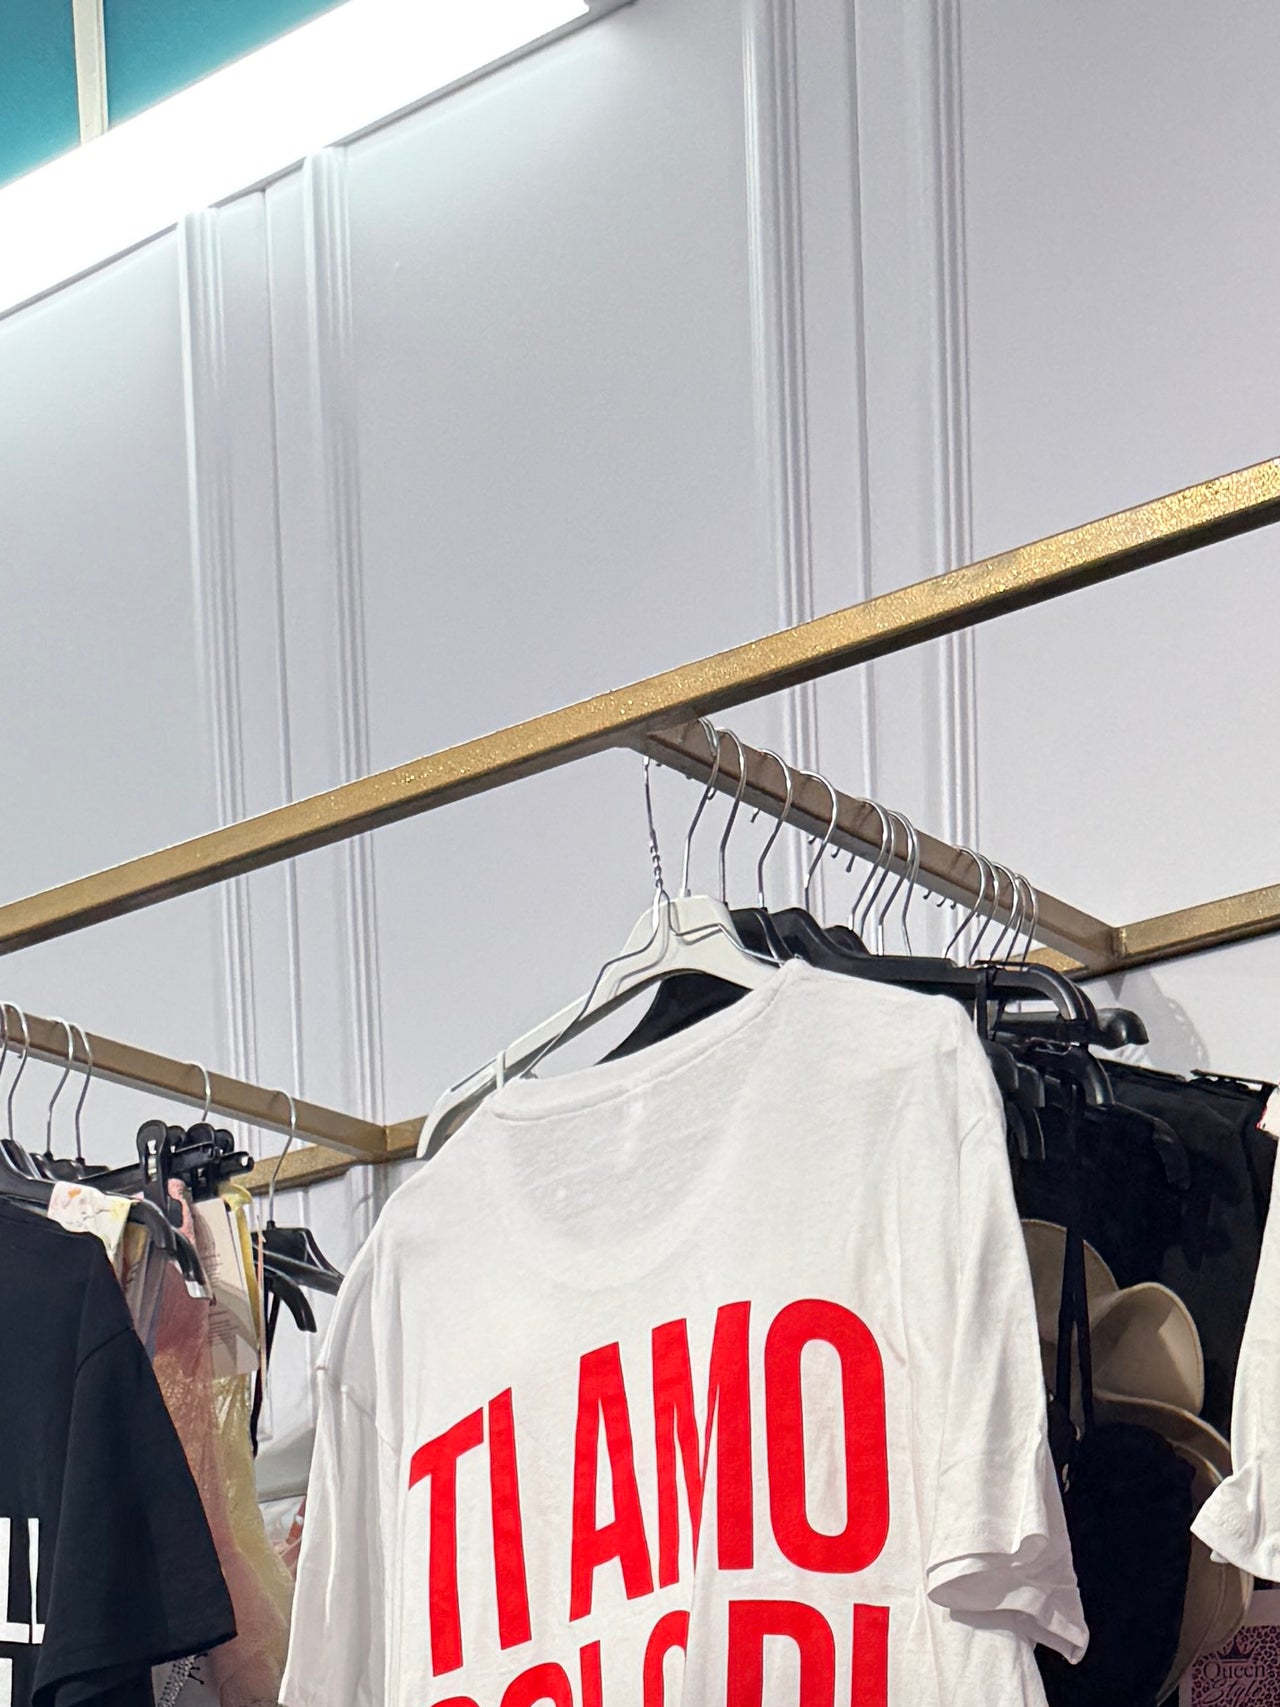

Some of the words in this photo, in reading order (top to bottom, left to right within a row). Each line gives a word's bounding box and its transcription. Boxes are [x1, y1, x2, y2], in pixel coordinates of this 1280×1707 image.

[409, 1387, 532, 1676] TI
[569, 1299, 889, 1622] AMO
[1203, 1661, 1266, 1681] Queen
